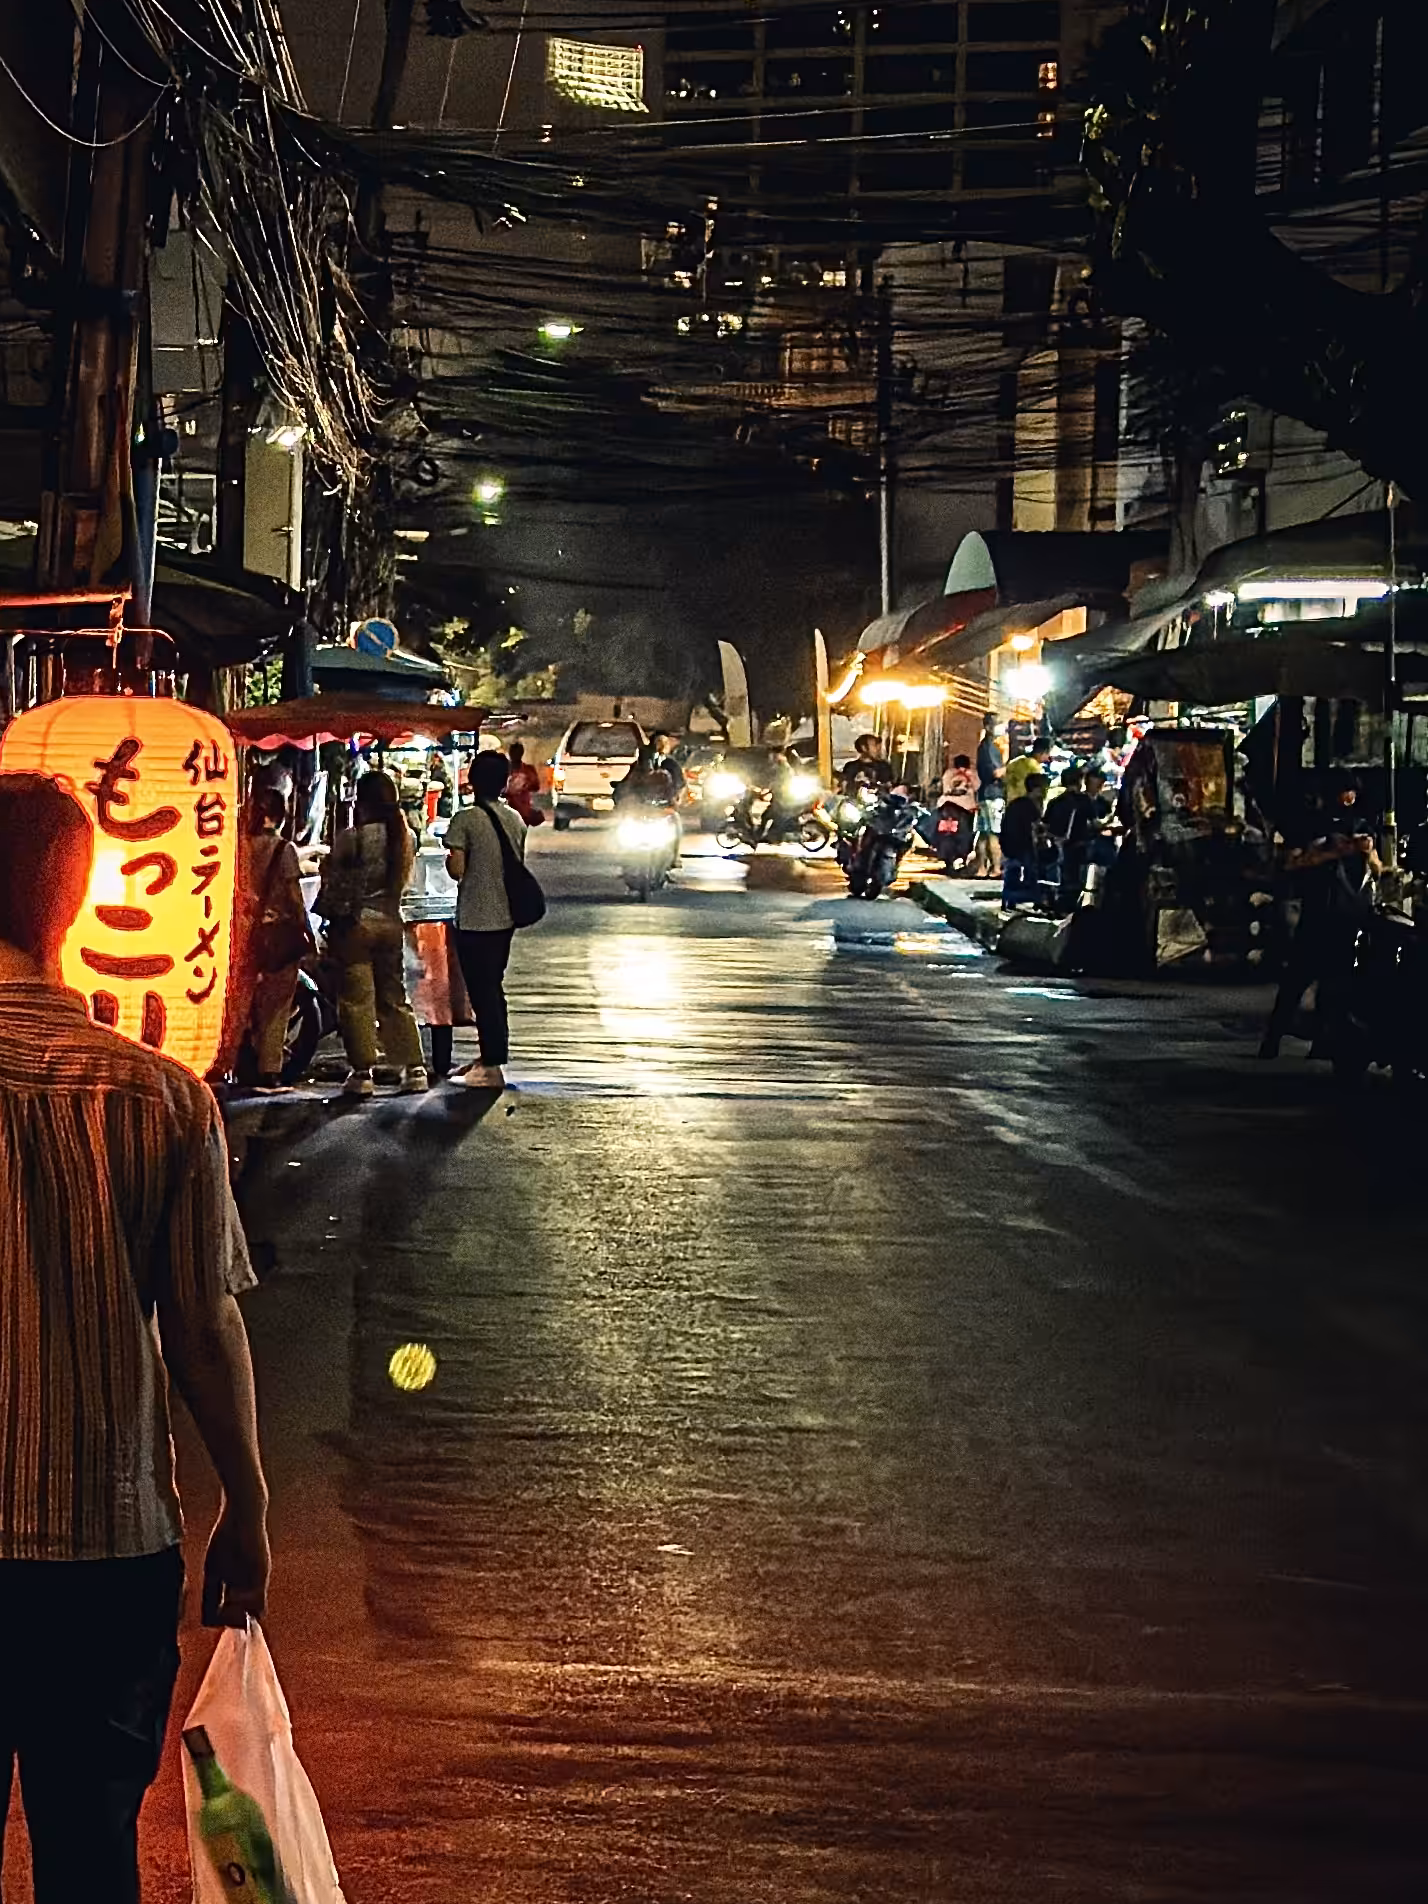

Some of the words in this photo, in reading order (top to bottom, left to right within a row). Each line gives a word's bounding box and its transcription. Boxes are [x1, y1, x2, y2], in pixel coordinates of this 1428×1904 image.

[182, 739, 230, 1004] 仙台ラーメン
